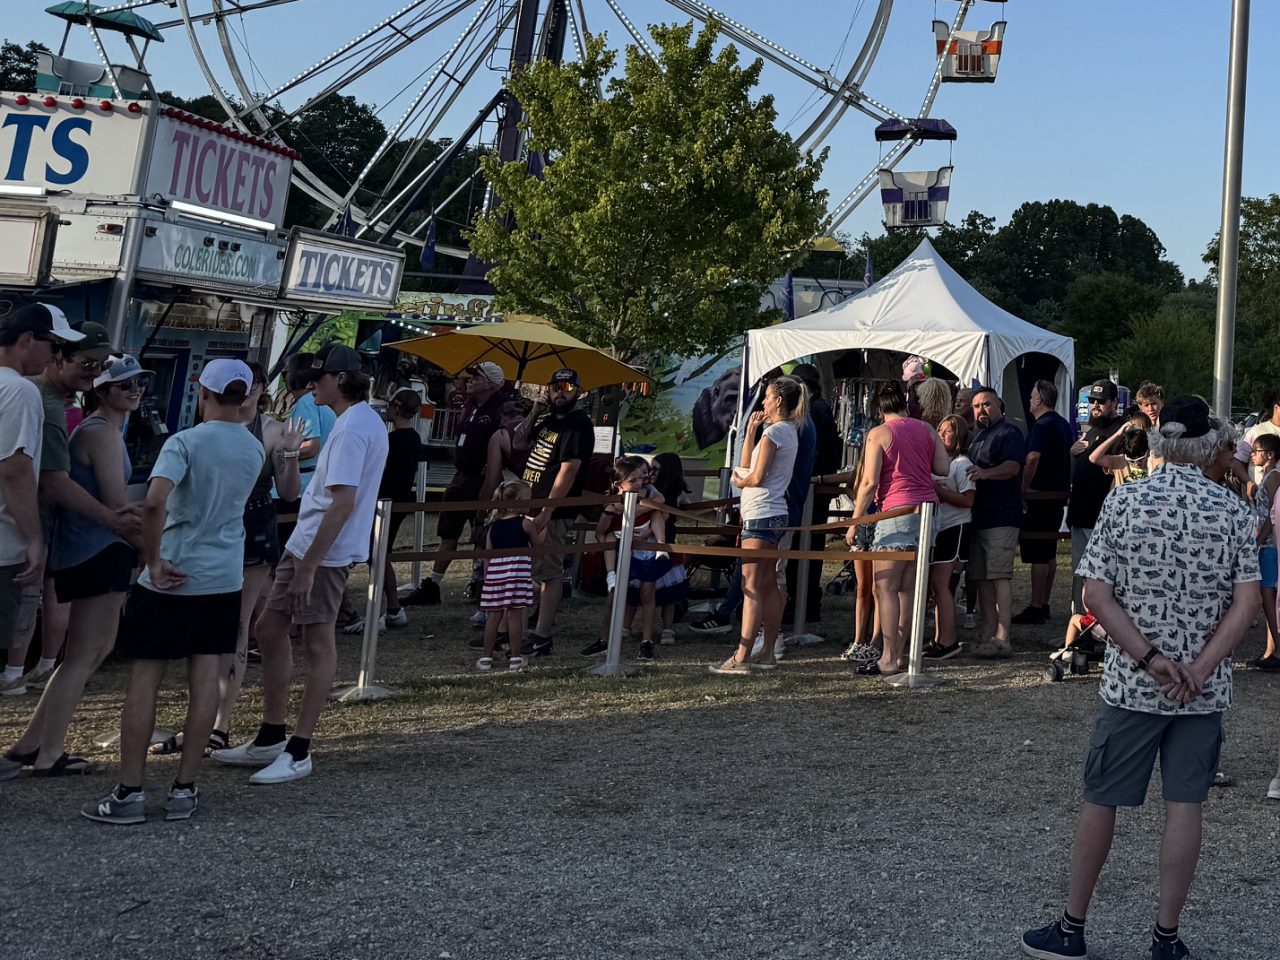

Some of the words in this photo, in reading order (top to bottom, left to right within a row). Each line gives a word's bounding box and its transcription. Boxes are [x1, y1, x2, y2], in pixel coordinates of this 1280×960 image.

[1, 113, 93, 185] TS
[169, 129, 278, 219] TICKETS
[298, 250, 395, 296] TICKETS
